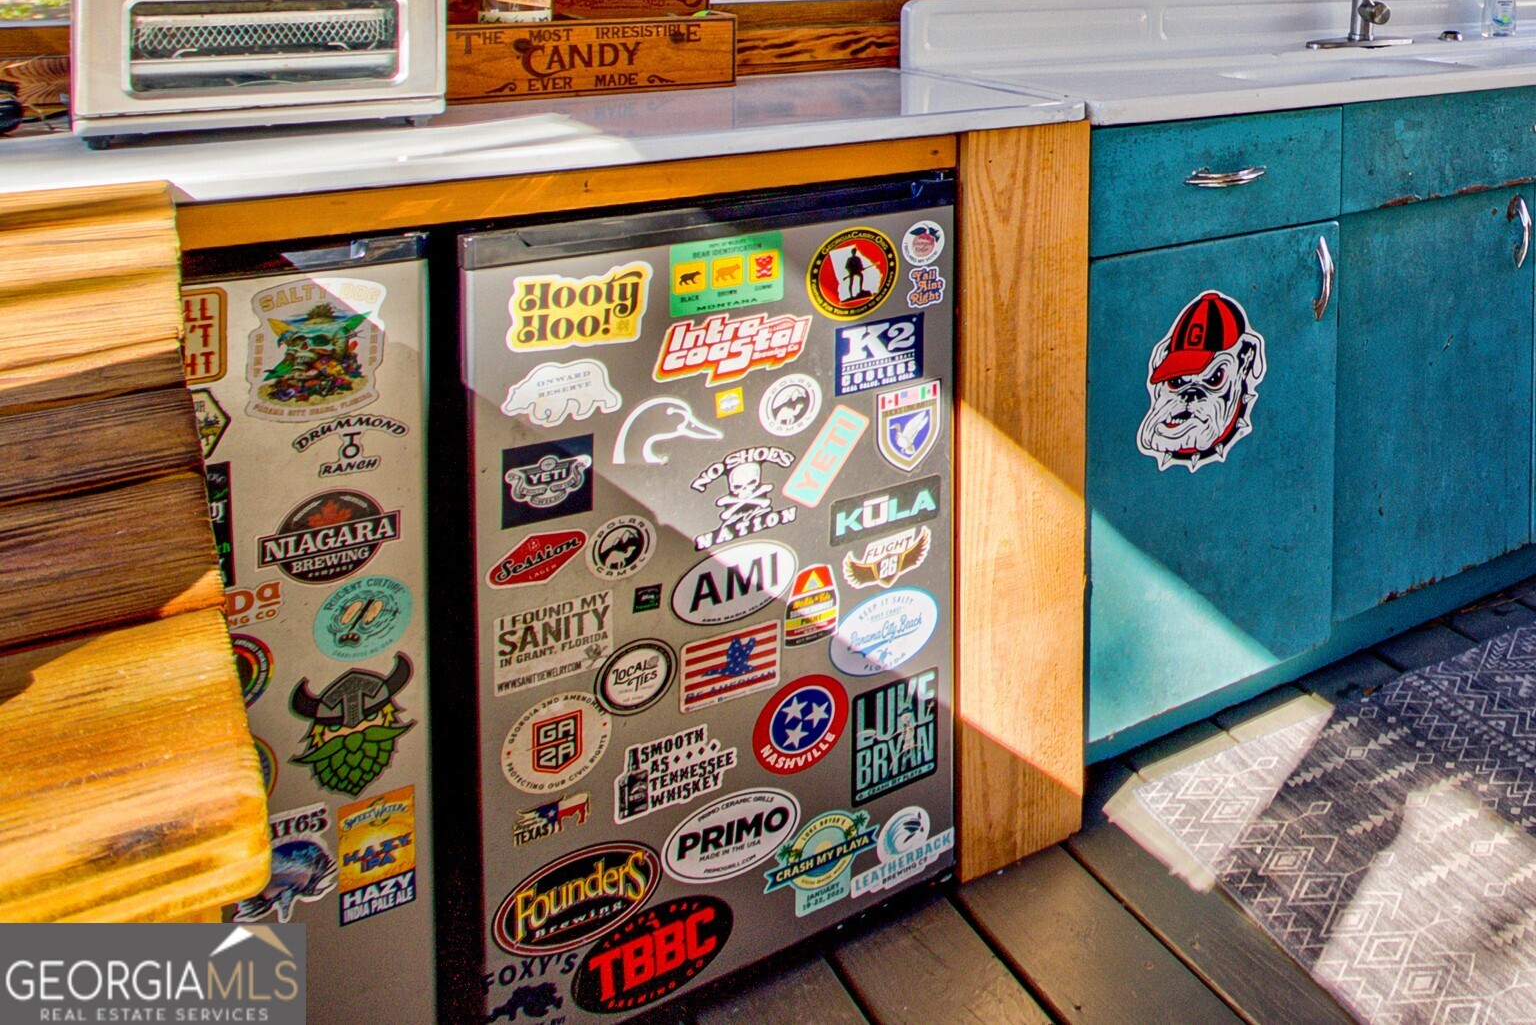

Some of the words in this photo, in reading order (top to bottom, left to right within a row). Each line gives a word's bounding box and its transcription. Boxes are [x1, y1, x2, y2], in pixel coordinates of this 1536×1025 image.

[456, 31, 505, 55] THE
[529, 28, 573, 43] MOST
[595, 24, 701, 44] IRRESISTIBLE
[520, 41, 641, 77] CANDY
[527, 77, 572, 92] EVER
[594, 74, 638, 87] MADE
[259, 283, 330, 312] SALTY
[340, 284, 381, 304] DOG
[519, 270, 643, 318] Hooty
[681, 295, 699, 303] BLACK
[697, 298, 758, 311] MONTANA
[910, 291, 940, 304] Right
[517, 308, 611, 344] Hoo!
[1187, 323, 1204, 347] G
[842, 322, 915, 364] K2
[536, 371, 591, 387] ONWARD
[771, 376, 813, 394] POLAR
[841, 360, 916, 386] COOLERS
[538, 381, 592, 399] RESERVE
[297, 417, 407, 450] DRUMMOND
[795, 411, 858, 492] YETI
[321, 458, 378, 474] RANCH
[529, 469, 566, 484] YETI
[692, 463, 724, 491] NO
[725, 447, 795, 469] SHOES
[263, 517, 396, 561] NIAGARA
[598, 518, 646, 538] POLAR
[696, 507, 796, 549] NATION
[291, 546, 370, 574] BREWING
[496, 536, 581, 582] Session
[865, 535, 912, 562] FLIGHT
[529, 564, 557, 580] LAGER
[596, 557, 646, 577] CAMEL
[879, 556, 898, 577] 26
[366, 578, 401, 593] CULTURE
[689, 552, 777, 613] AMI
[255, 609, 276, 620] CO
[500, 619, 504, 631] I
[512, 602, 573, 628] FOUND
[581, 592, 608, 610] MY
[859, 603, 876, 620] KEEP
[881, 598, 888, 606] IT
[892, 596, 914, 604] SALTY
[498, 605, 610, 656] SANITY
[882, 620, 897, 643] City
[897, 612, 922, 633] Beach
[500, 656, 512, 668] IN
[516, 646, 557, 664] GRANT,
[562, 632, 608, 652] FLORIDA
[864, 653, 906, 671] FLORIDA
[613, 659, 658, 685] LOCAL
[632, 670, 658, 692] TIES
[710, 670, 775, 694] AMERICAN
[508, 707, 540, 744] GEORGIA
[541, 697, 560, 709] 2ND
[562, 694, 607, 717] AMENDMENT
[856, 672, 935, 751] LUKE
[640, 727, 705, 764] SMOOTH
[760, 731, 836, 770] NASHVILLE
[856, 723, 934, 790] BRYAN
[506, 763, 544, 790] PROTECTING
[547, 778, 566, 789] OUR
[568, 764, 589, 782] CIVIL
[590, 733, 608, 763] RIGHTS
[649, 751, 734, 790] TENNESSEE
[651, 755, 669, 773] AS
[650, 772, 720, 808] WHISKEY
[698, 807, 719, 822] PRIMO
[721, 797, 752, 810] CERAMIC
[514, 825, 549, 846] TEXAS
[677, 806, 789, 862] PRIMO
[802, 826, 817, 841] LUKE
[361, 853, 396, 873] IPA
[699, 852, 720, 862] MADE
[732, 843, 745, 852] THE
[747, 839, 761, 848] USA
[776, 860, 814, 882] CRASH
[817, 850, 834, 866] MY
[837, 836, 869, 857] PLAYA
[855, 834, 951, 891] LEATHERBACK
[882, 864, 916, 884] BREWING
[343, 871, 414, 910] HAZY
[515, 850, 648, 948] Founders
[807, 882, 840, 901] JANUARY
[343, 903, 370, 924] INDIA
[371, 894, 394, 913] PALE
[395, 888, 413, 905] ALE
[670, 901, 699, 913] BAY
[589, 906, 717, 1002] TBBC
[482, 953, 578, 996] FOXY'S
[608, 981, 676, 1009] BREWING
